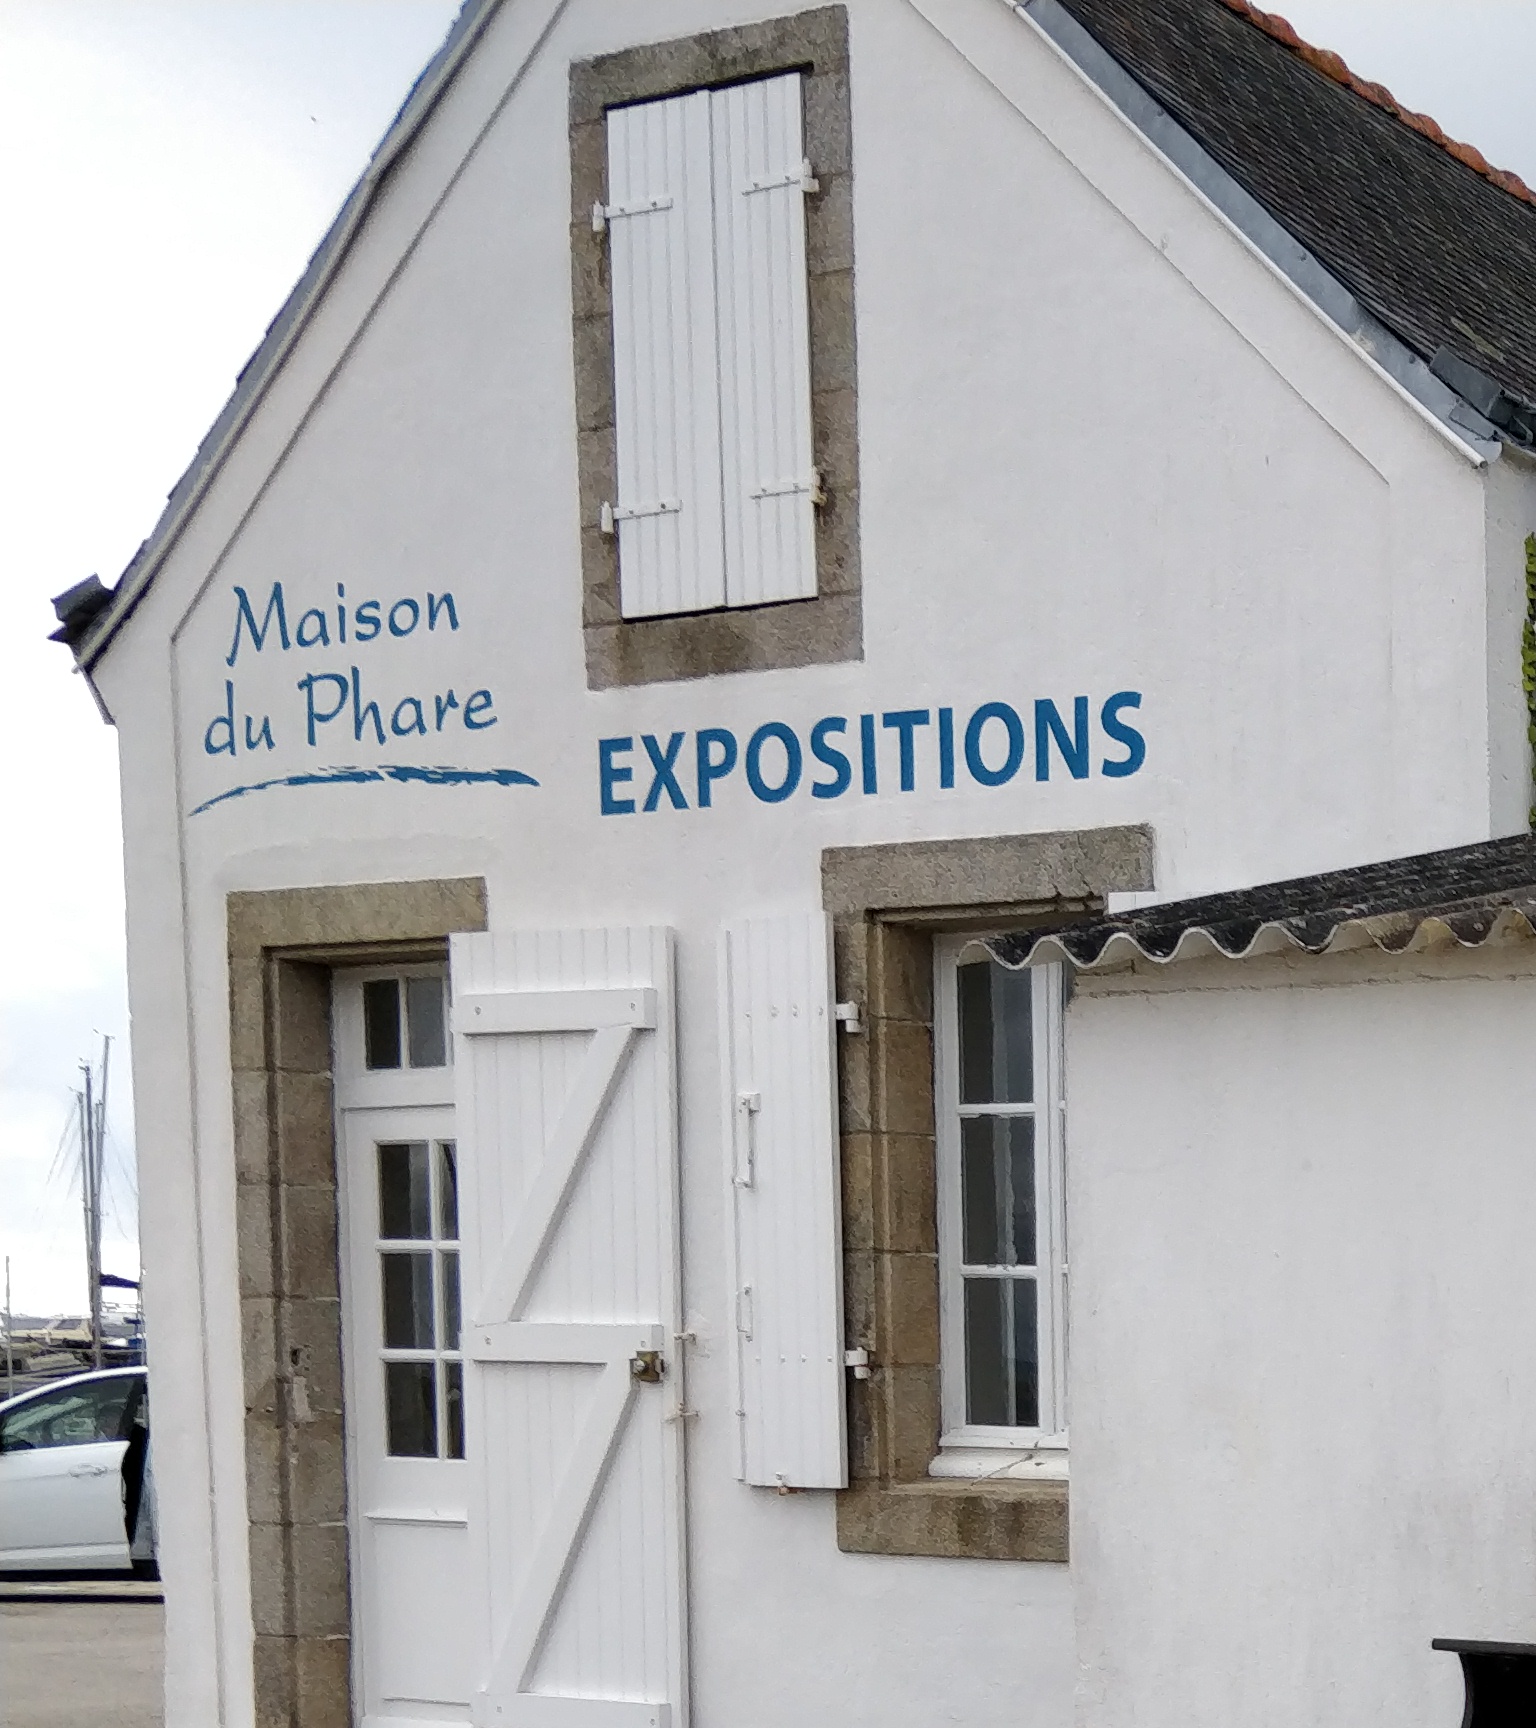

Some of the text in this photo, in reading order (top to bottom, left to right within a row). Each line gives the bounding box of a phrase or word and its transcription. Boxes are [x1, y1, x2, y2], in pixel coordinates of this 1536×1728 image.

[227, 582, 460, 667] Maison
[204, 666, 498, 756] du Phare
[599, 690, 1148, 817] EXPOSITIONS
